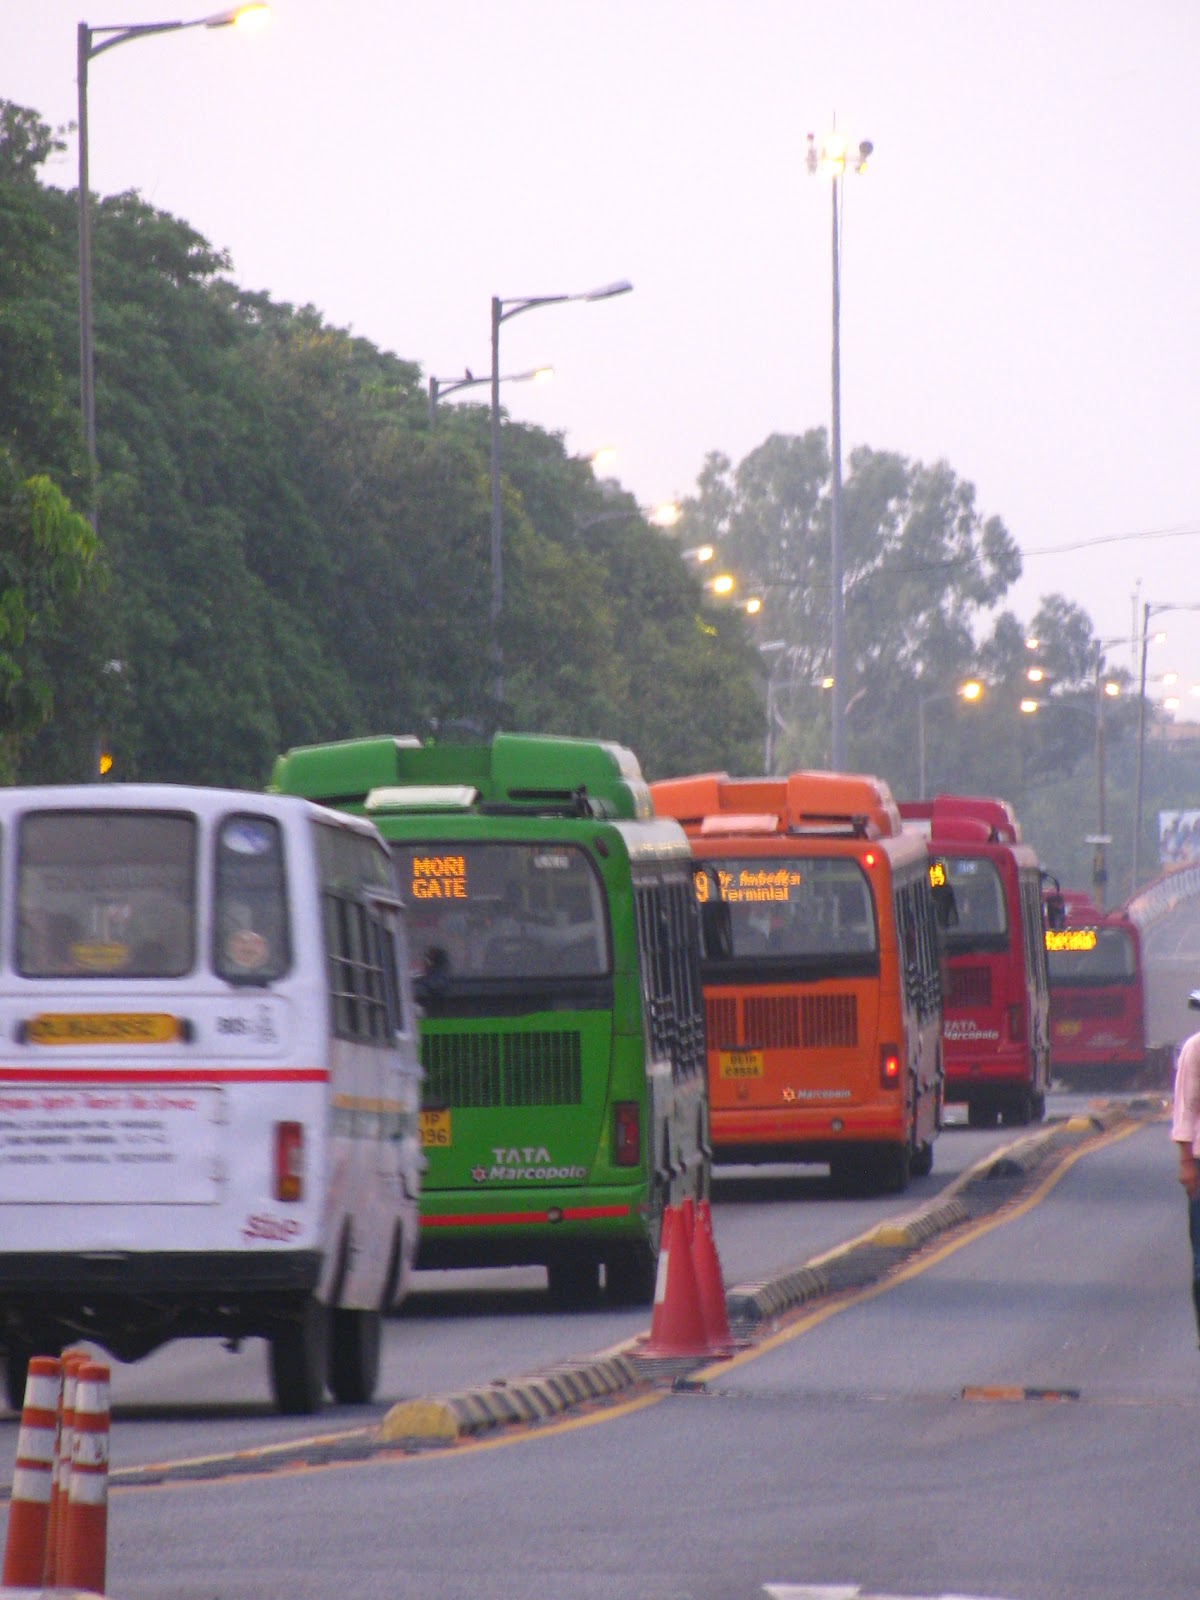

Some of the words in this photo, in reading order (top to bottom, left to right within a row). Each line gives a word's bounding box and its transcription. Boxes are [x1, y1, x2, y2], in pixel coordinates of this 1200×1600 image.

[413, 855, 466, 877] MORI
[412, 878, 468, 899] GATE
[491, 1148, 551, 1164] TATA
[489, 1164, 588, 1181] Marcopolo
